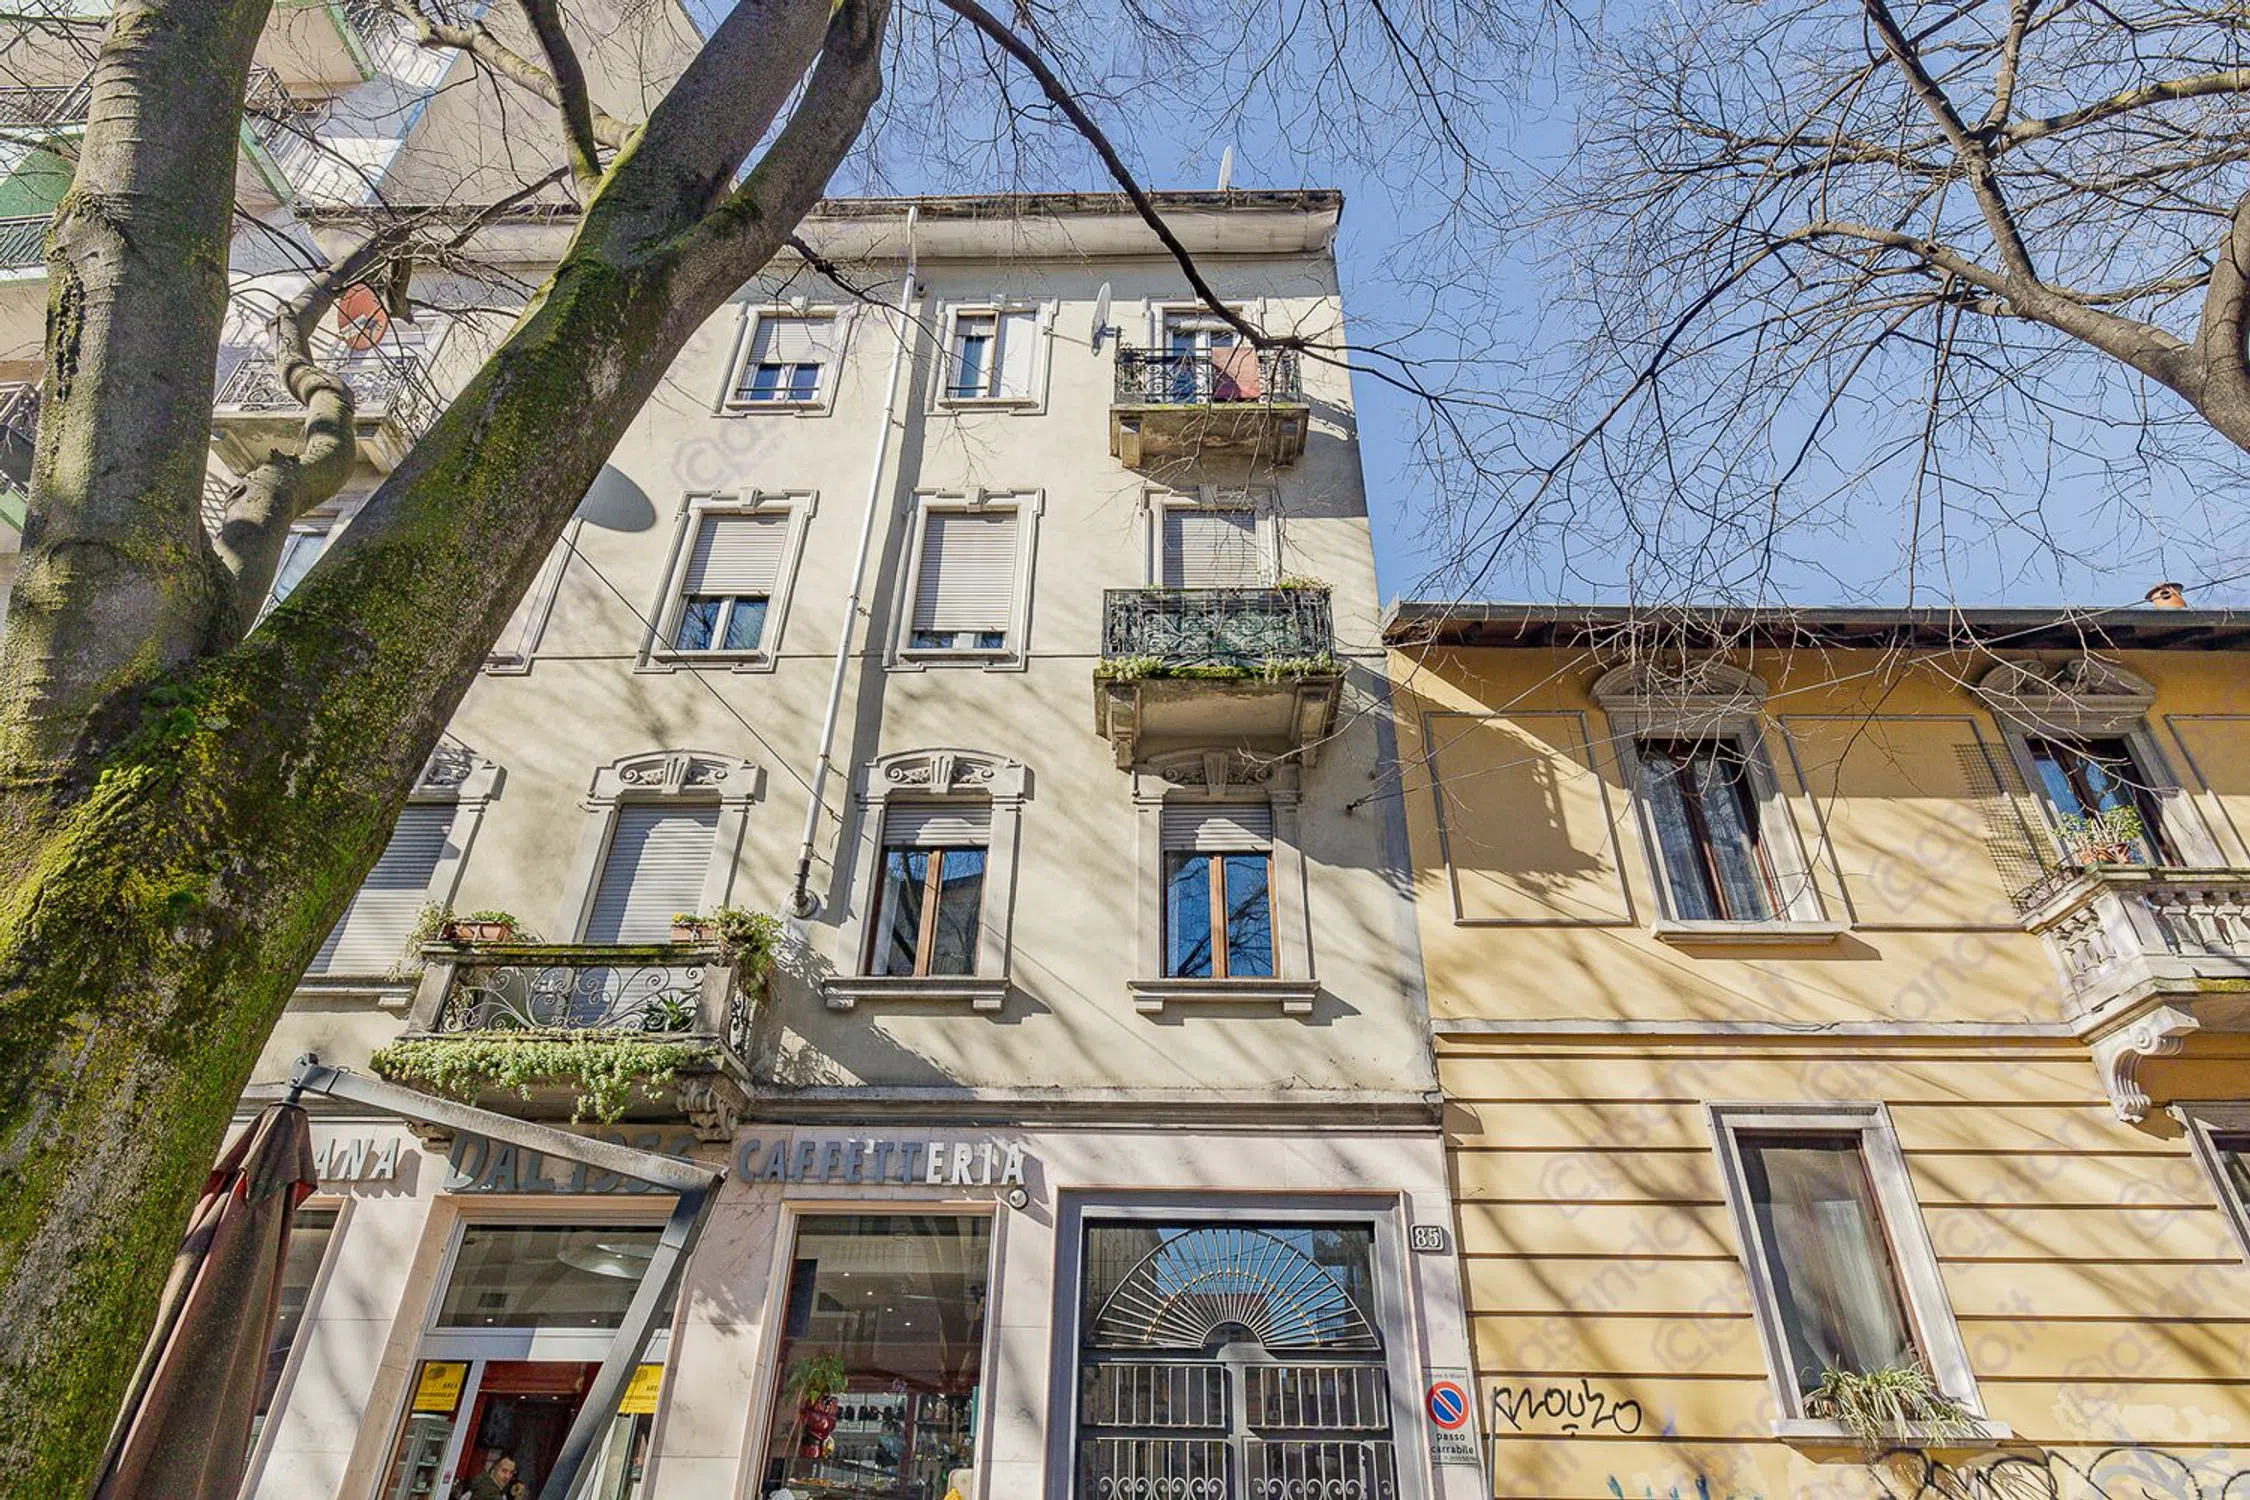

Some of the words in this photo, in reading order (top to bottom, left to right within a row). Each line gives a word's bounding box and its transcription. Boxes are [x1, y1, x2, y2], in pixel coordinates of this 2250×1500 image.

[443, 1129, 554, 1191] DAL
[738, 1138, 1025, 1185] CAFFETTERIA
[1415, 1227, 1441, 1248] 85
[1436, 1433, 1466, 1442] passo
[1430, 1445, 1475, 1454] carrabile
